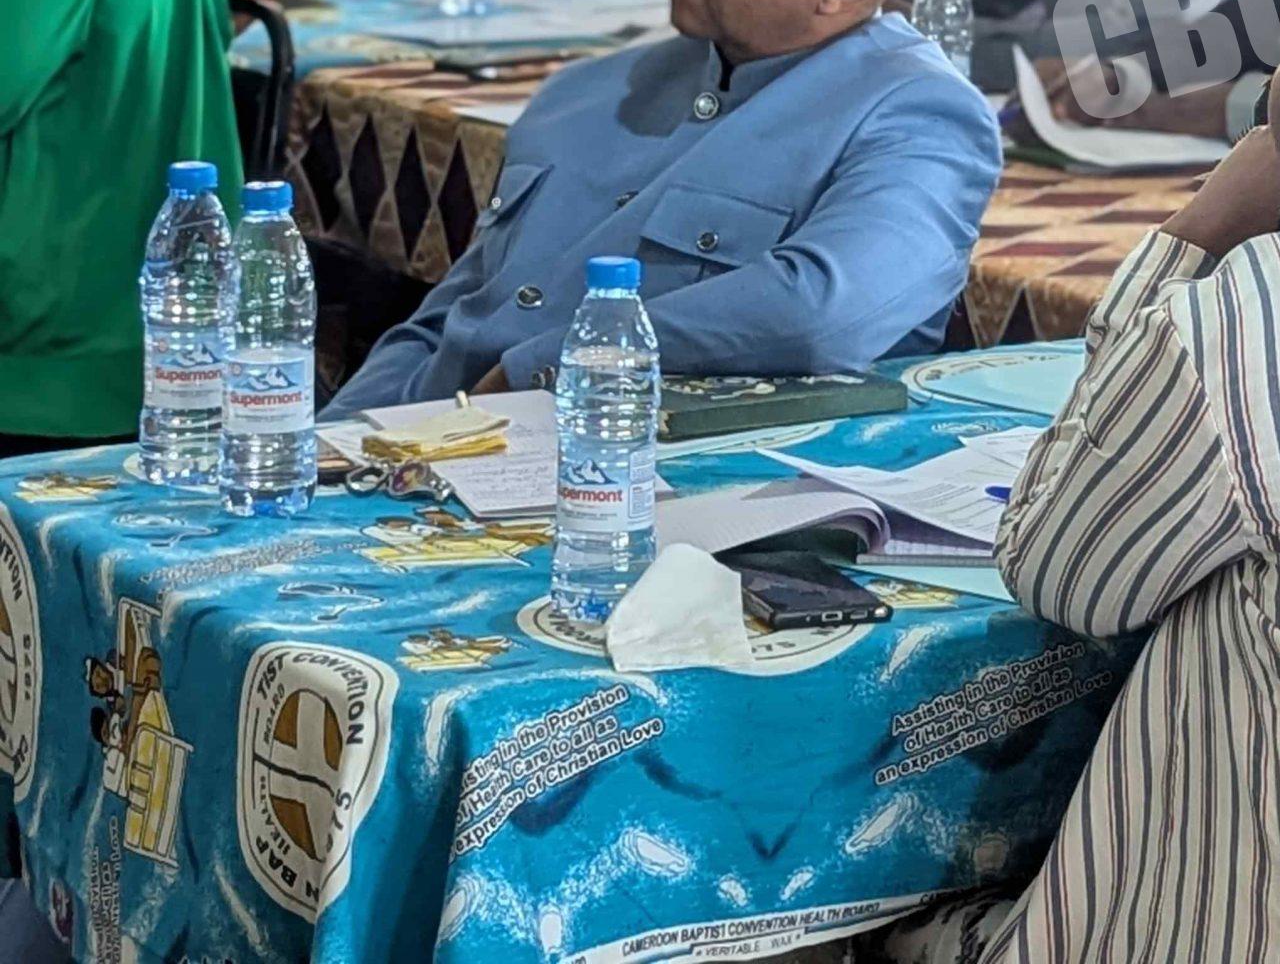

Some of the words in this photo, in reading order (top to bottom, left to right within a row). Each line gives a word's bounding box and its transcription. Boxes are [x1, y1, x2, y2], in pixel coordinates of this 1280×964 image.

[155, 367, 222, 382] Supermon
[292, 652, 370, 745] CONVENTION
[893, 693, 964, 734] Assisting
[967, 682, 984, 701] in
[985, 670, 1009, 691] the
[1010, 642, 1084, 682] Provision
[904, 732, 922, 751] of
[924, 711, 974, 743] Health
[1013, 686, 1032, 704] to
[501, 739, 518, 759] in
[518, 726, 546, 746] the
[548, 685, 628, 733] Provision
[511, 752, 549, 777] Care
[551, 739, 570, 757] to
[572, 723, 593, 747] all
[596, 717, 617, 736] as
[876, 765, 898, 784] an
[900, 728, 988, 772] expression
[989, 718, 1006, 738] of
[526, 775, 546, 797] of
[546, 739, 618, 784] Christian
[621, 718, 662, 746] Love
[622, 931, 679, 957] CAMEROON
[681, 923, 726, 944] BAPTIST
[727, 912, 799, 936] CONVENTION
[799, 907, 841, 925] HEALTH
[705, 939, 760, 956] VERITABLE
